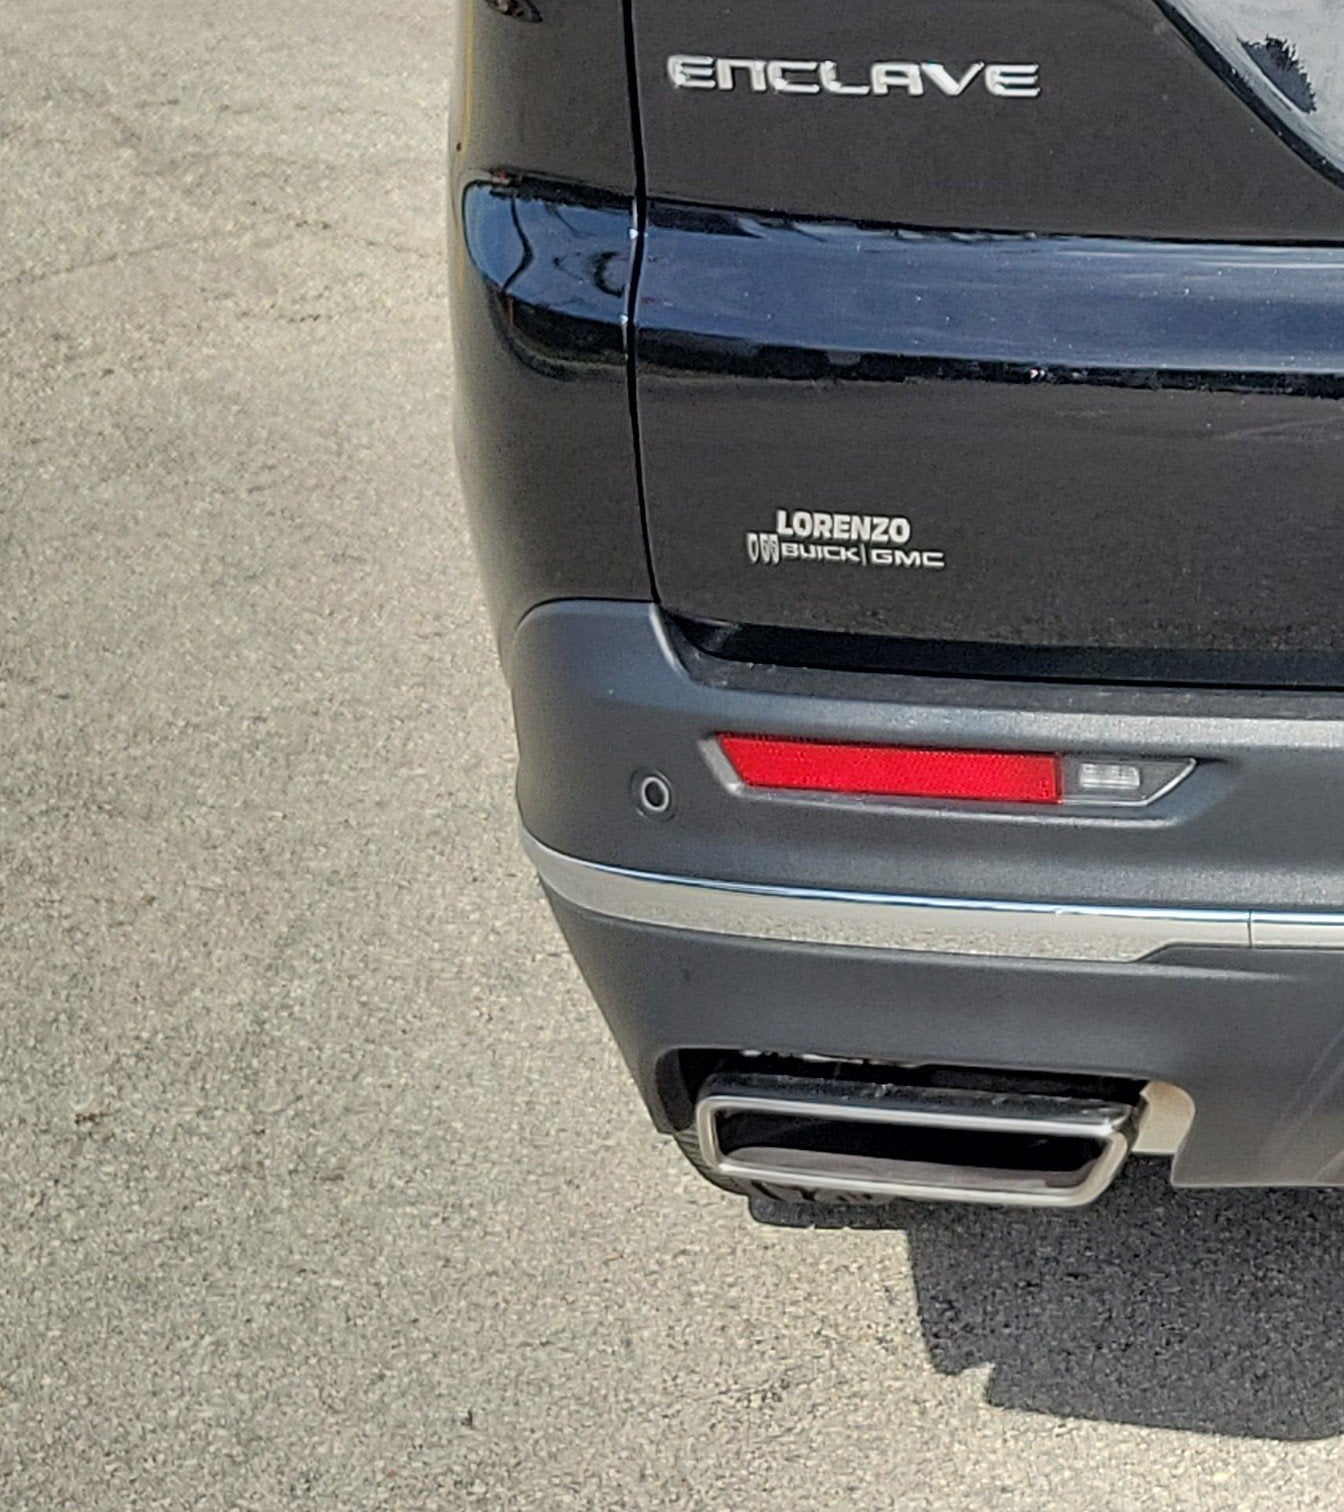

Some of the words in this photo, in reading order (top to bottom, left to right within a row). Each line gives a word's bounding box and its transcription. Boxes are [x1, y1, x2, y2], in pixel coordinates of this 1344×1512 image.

[666, 53, 1041, 97] ENCLAVE
[776, 509, 912, 545] LORENZO
[780, 542, 861, 564] BUICK
[870, 548, 946, 569] GMC
